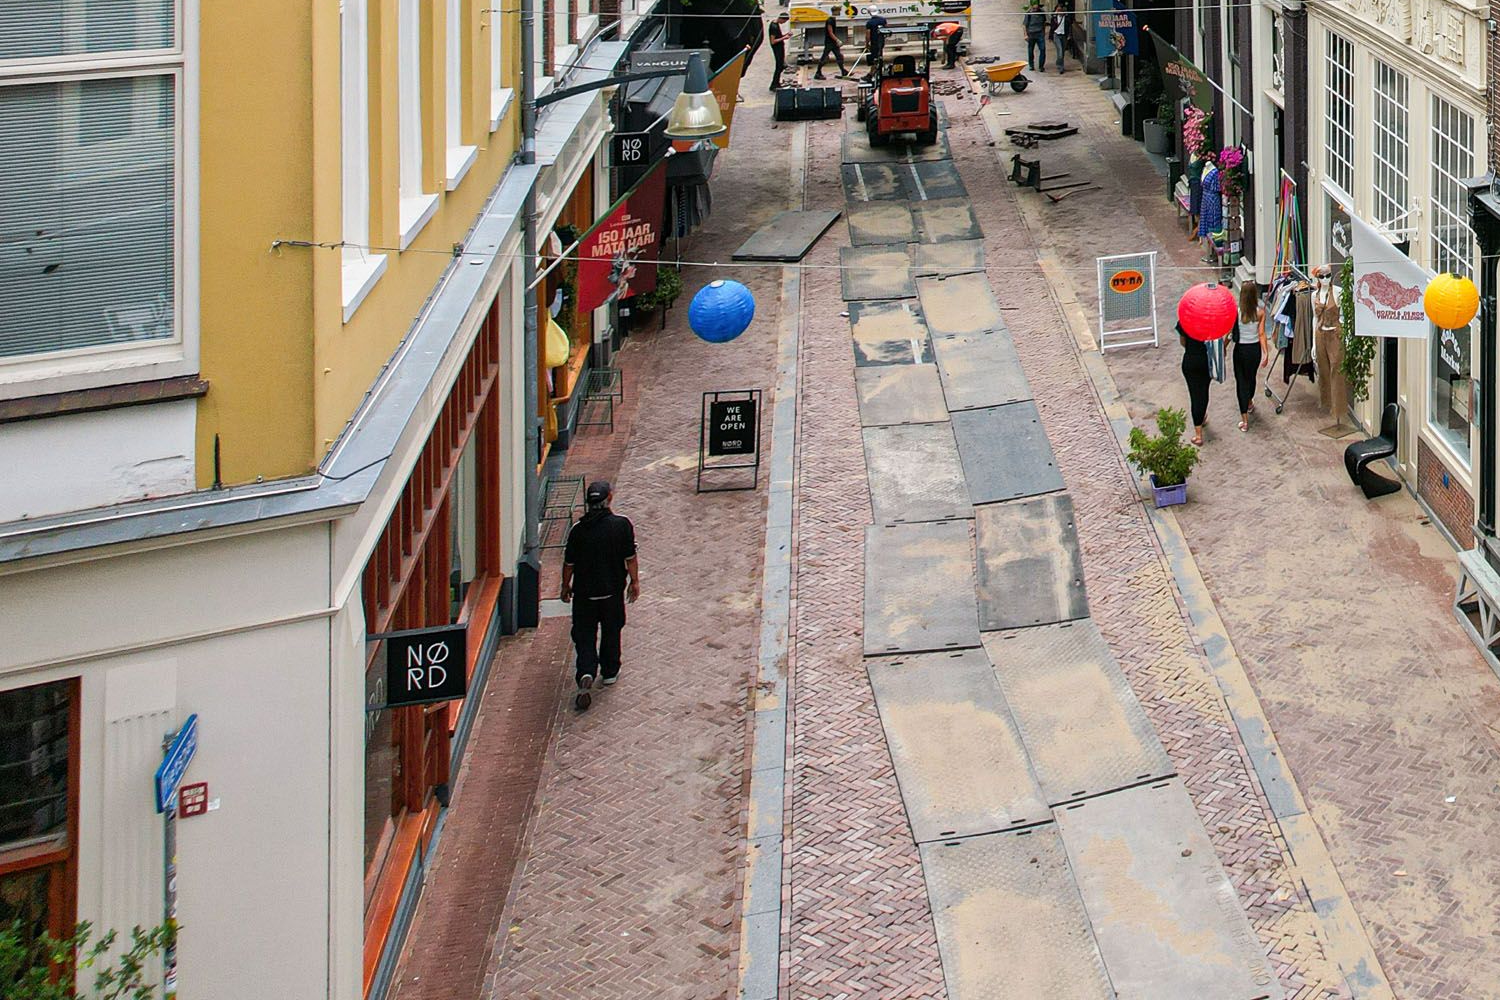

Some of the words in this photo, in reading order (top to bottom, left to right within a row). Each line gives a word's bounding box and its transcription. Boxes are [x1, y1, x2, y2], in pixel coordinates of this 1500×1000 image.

[622, 138, 642, 149] NØ
[622, 150, 641, 161] RD
[598, 229, 619, 245] 150
[620, 223, 651, 240] JAAR
[591, 240, 625, 257] MATA
[627, 232, 655, 250] HARI
[726, 406, 741, 414] WE
[724, 414, 742, 422] ARE
[720, 422, 746, 431] OPEN
[407, 641, 449, 668] NØ
[407, 665, 447, 691] RD
